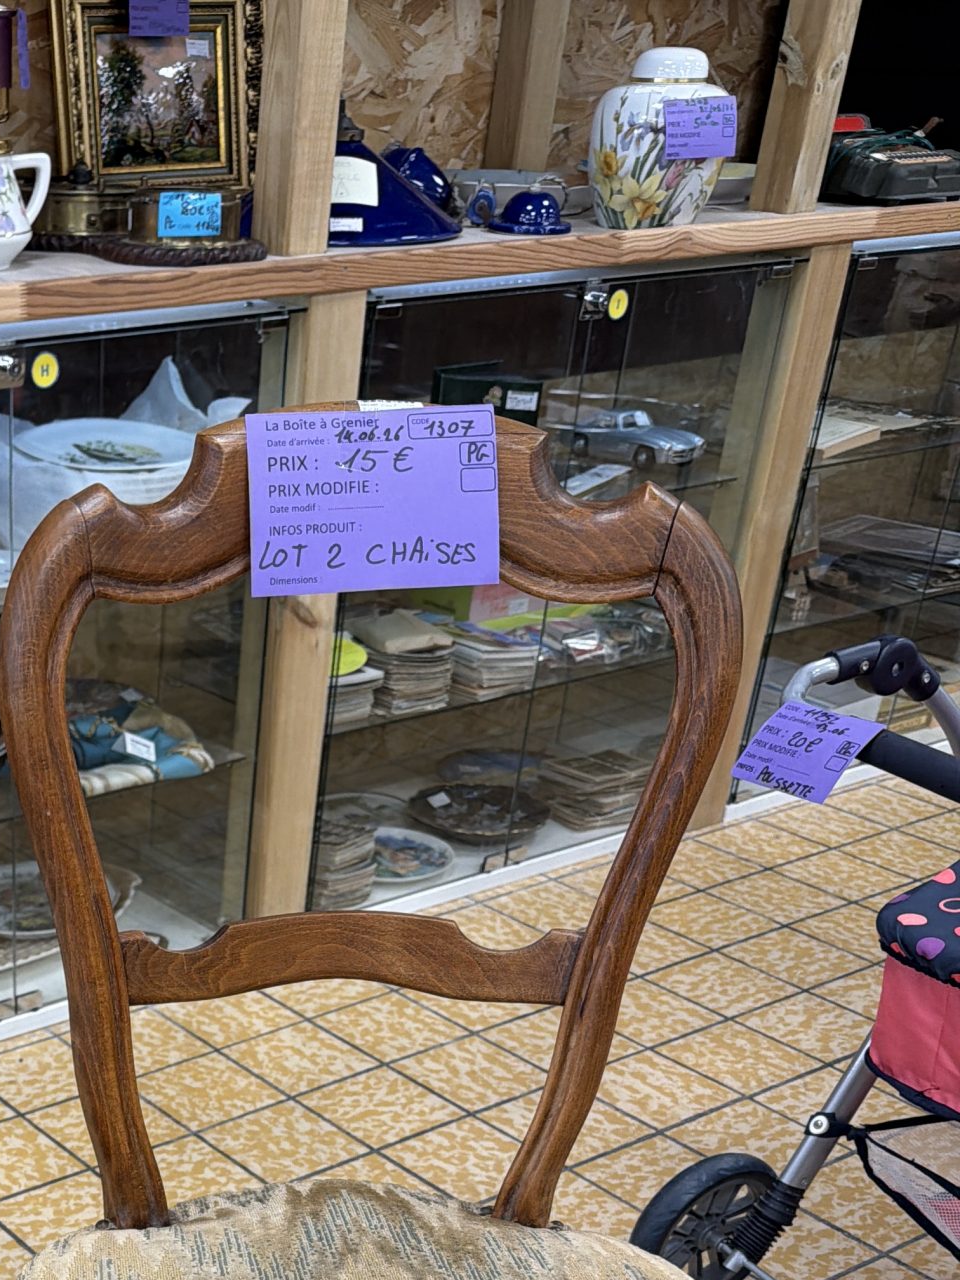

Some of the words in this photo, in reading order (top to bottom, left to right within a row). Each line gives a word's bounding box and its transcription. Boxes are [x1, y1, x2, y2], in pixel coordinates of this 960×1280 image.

[40, 364, 50, 377] H
[265, 421, 279, 432] La
[283, 419, 316, 431] Boîte
[320, 417, 328, 429] à
[331, 416, 380, 429] Grenier
[423, 420, 475, 437] 1307
[267, 439, 287, 448] Date
[467, 441, 490, 463] PG
[267, 455, 308, 473] PRIX
[268, 483, 301, 498] PRIX
[306, 480, 370, 496] MODIFIE
[269, 505, 289, 514] Date
[291, 503, 316, 512] modif
[269, 524, 303, 537] INFOS
[305, 521, 356, 535] PRODUIT
[259, 540, 309, 570] LOT
[326, 543, 346, 569] 2
[269, 576, 318, 586] Dimensions
[761, 724, 782, 737] PRIX
[751, 738, 769, 749] PRIX
